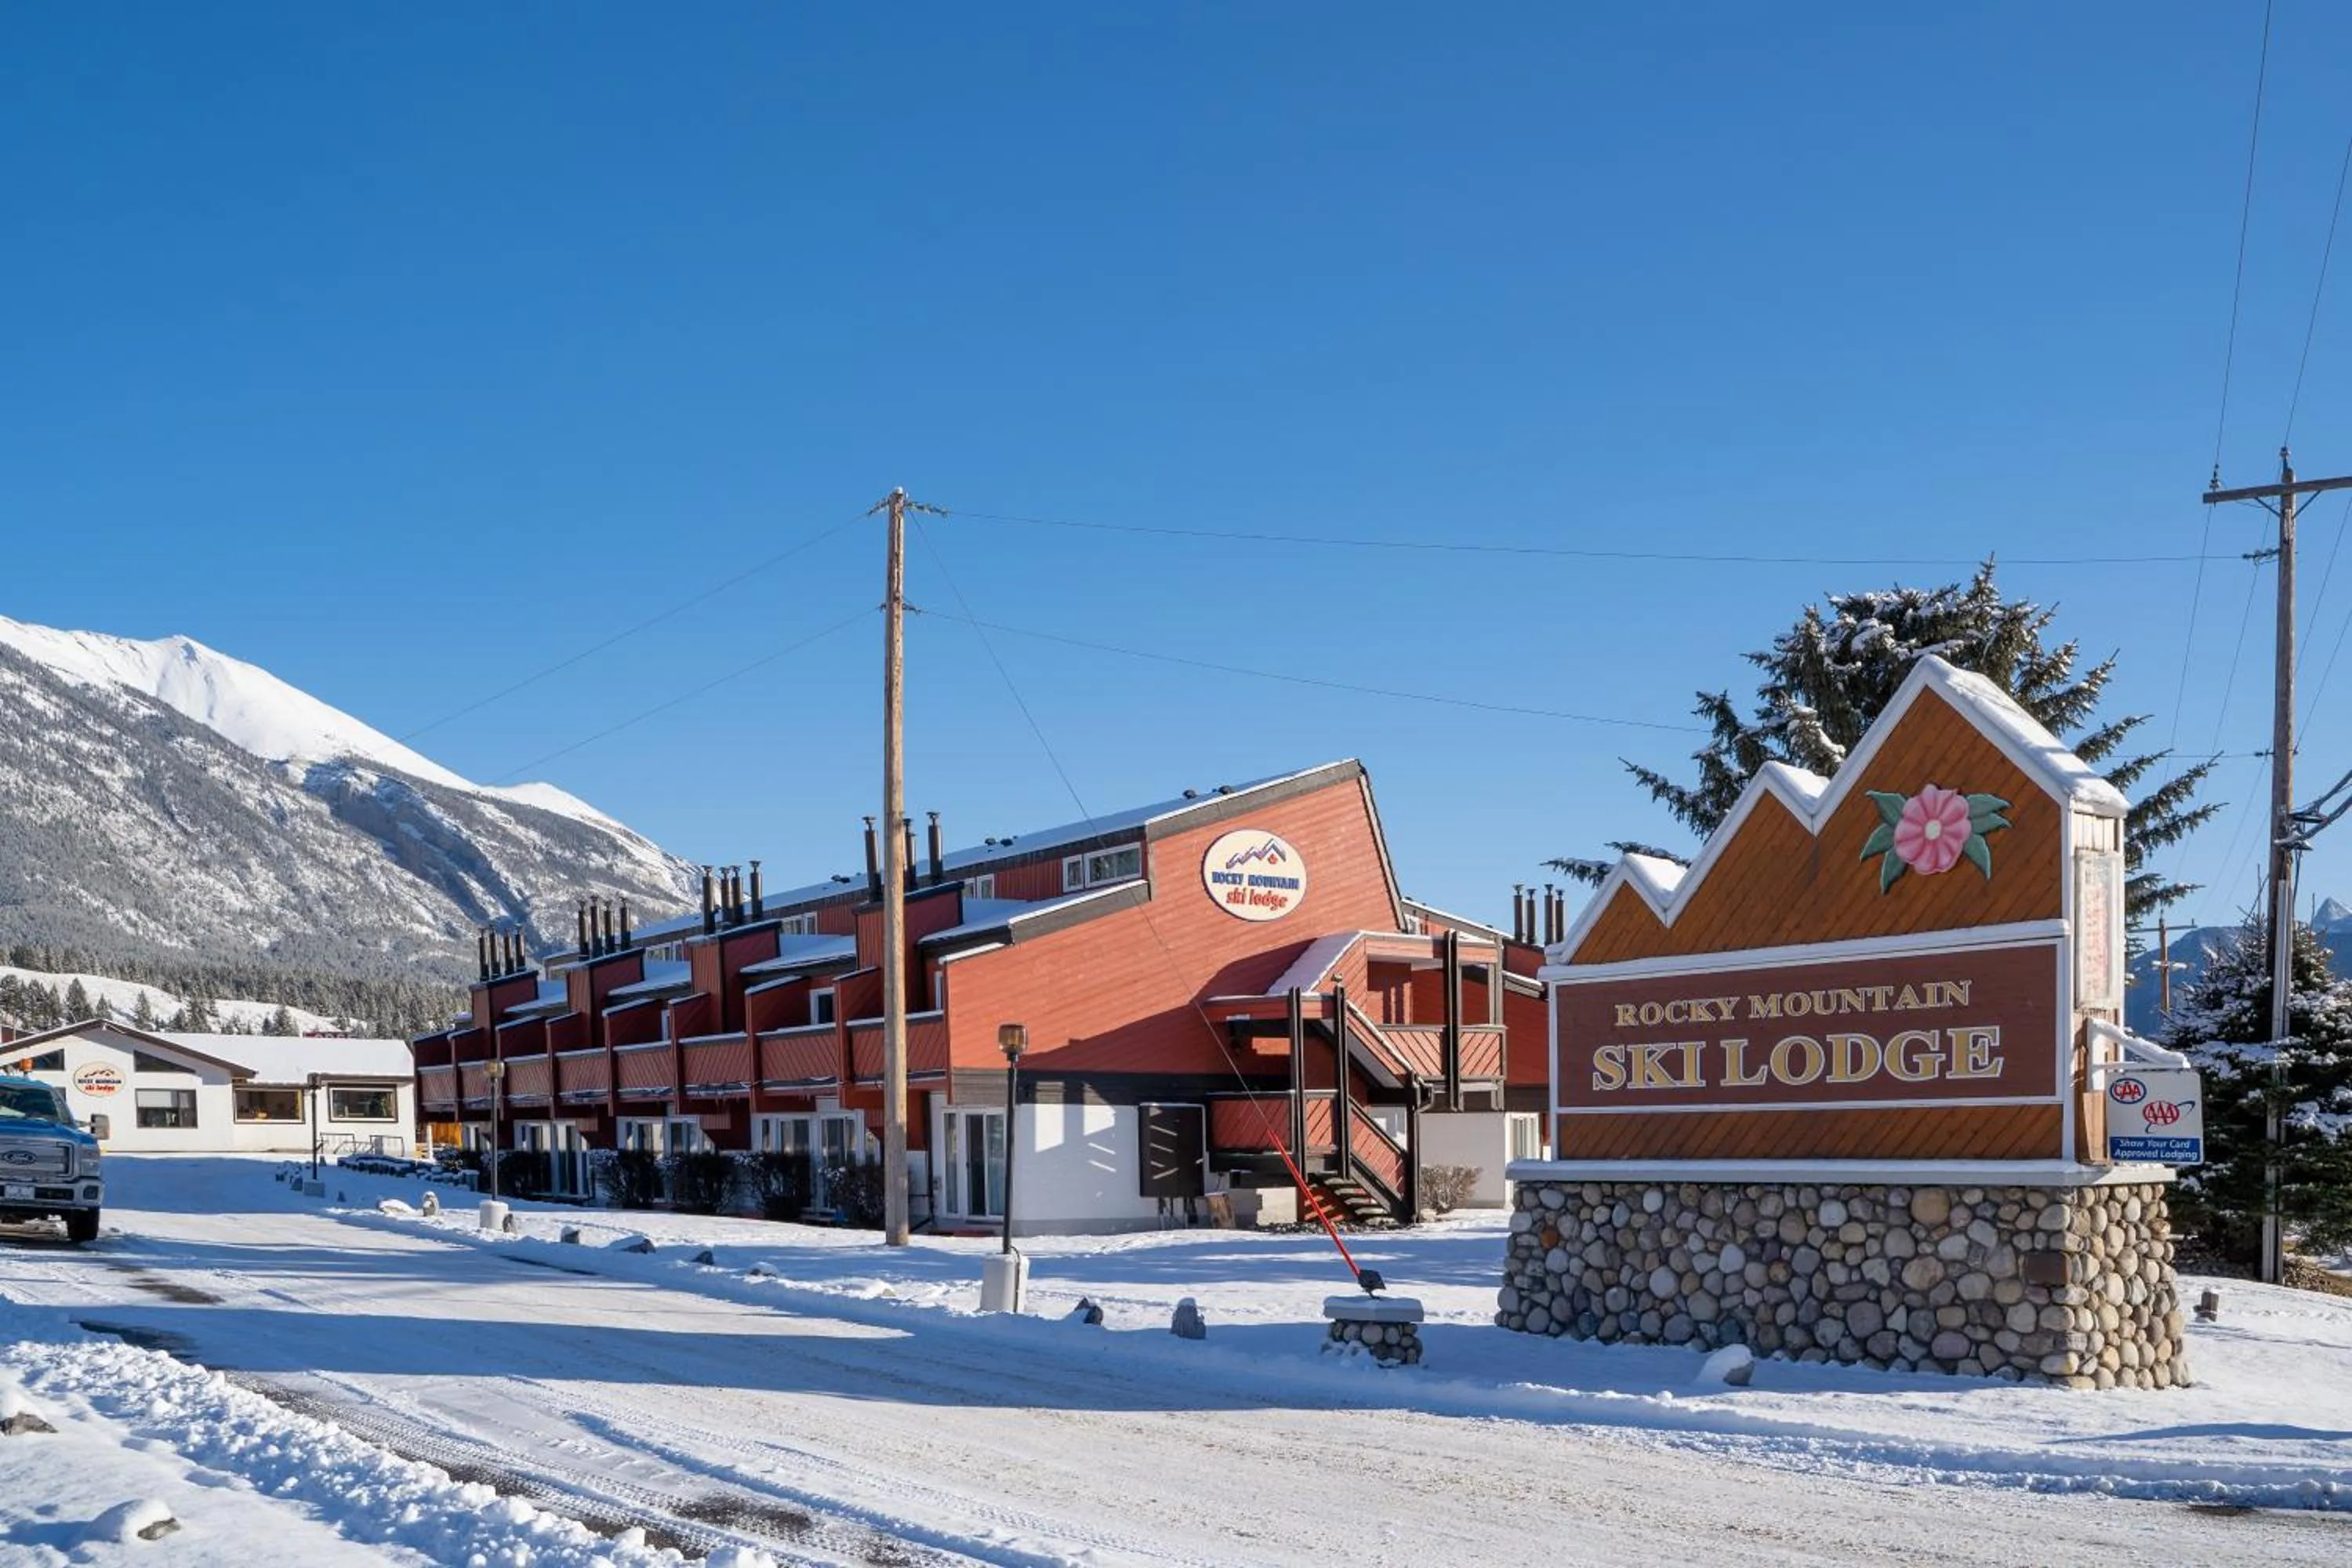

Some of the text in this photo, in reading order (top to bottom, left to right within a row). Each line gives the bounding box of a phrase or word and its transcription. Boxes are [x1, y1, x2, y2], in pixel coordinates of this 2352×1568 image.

[1211, 872, 1299, 890] ROCKY MOUNTAIN
[1226, 887, 1288, 910] ski lodge
[1613, 979, 1973, 1028] ROCKY MOUNTAIN
[1592, 1025, 2005, 1091] SKI LODGE
[2146, 1101, 2178, 1124] AAA
[2114, 1149, 2198, 1160] Approved Lodging
[2169, 1140, 2190, 1149] Card
